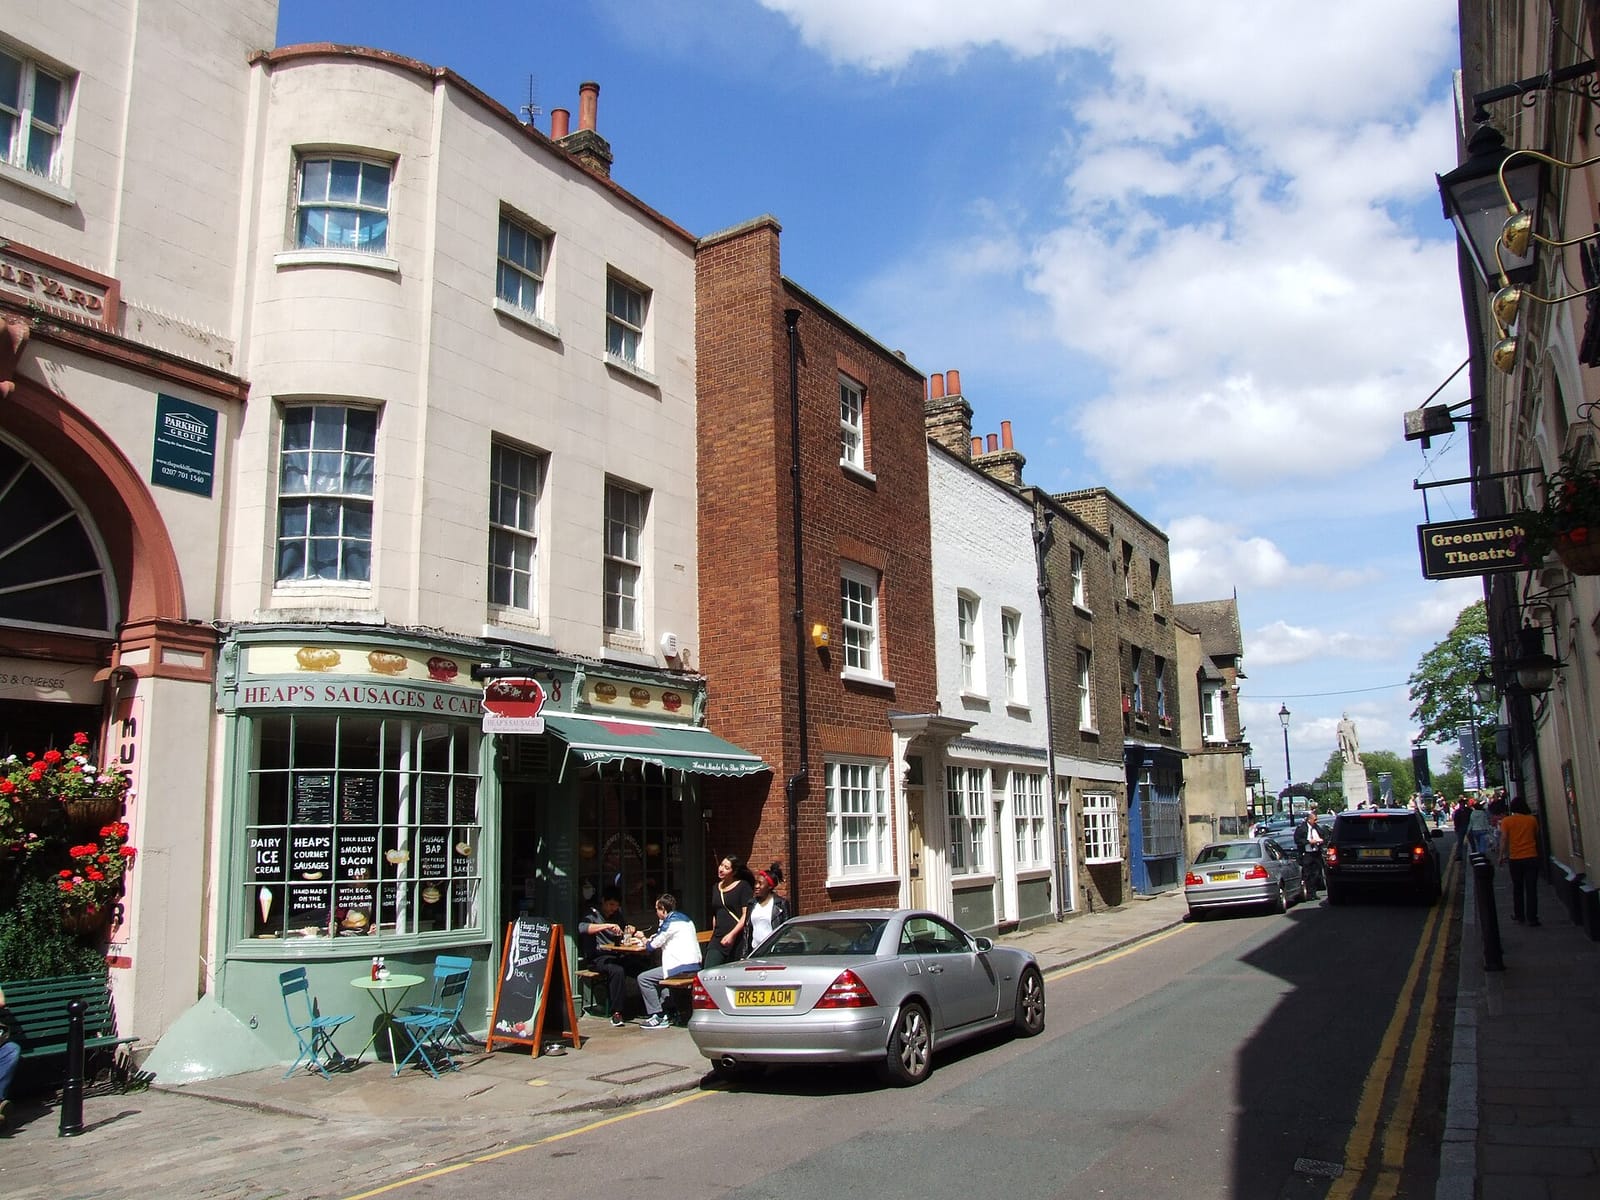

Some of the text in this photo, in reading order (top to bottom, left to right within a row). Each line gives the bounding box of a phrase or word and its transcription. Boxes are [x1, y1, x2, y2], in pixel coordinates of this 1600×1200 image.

[38, 276, 102, 310] YARD
[165, 416, 208, 435] PARKHILL
[170, 428, 202, 442] GROUP
[162, 467, 177, 479] 0207
[178, 471, 189, 480] 701
[1431, 525, 1526, 564] Greenwich Theatre
[10, 675, 19, 685] &
[21, 676, 65, 688] CHEESES
[551, 679, 562, 702] 8
[244, 685, 315, 703] HEAP'S
[324, 686, 425, 708] SAUSAGES
[433, 694, 444, 710] &
[250, 838, 281, 848] DAIRY
[294, 837, 330, 848] HEAP'S
[340, 845, 373, 853] SMOKEY
[425, 844, 442, 854] BAP
[257, 850, 279, 864] ICE
[340, 856, 374, 866] BACON
[254, 866, 280, 874] CREAM
[293, 862, 329, 870] SAUSAGES
[347, 867, 367, 876] BAP
[738, 990, 791, 1003] RK53 AOM
